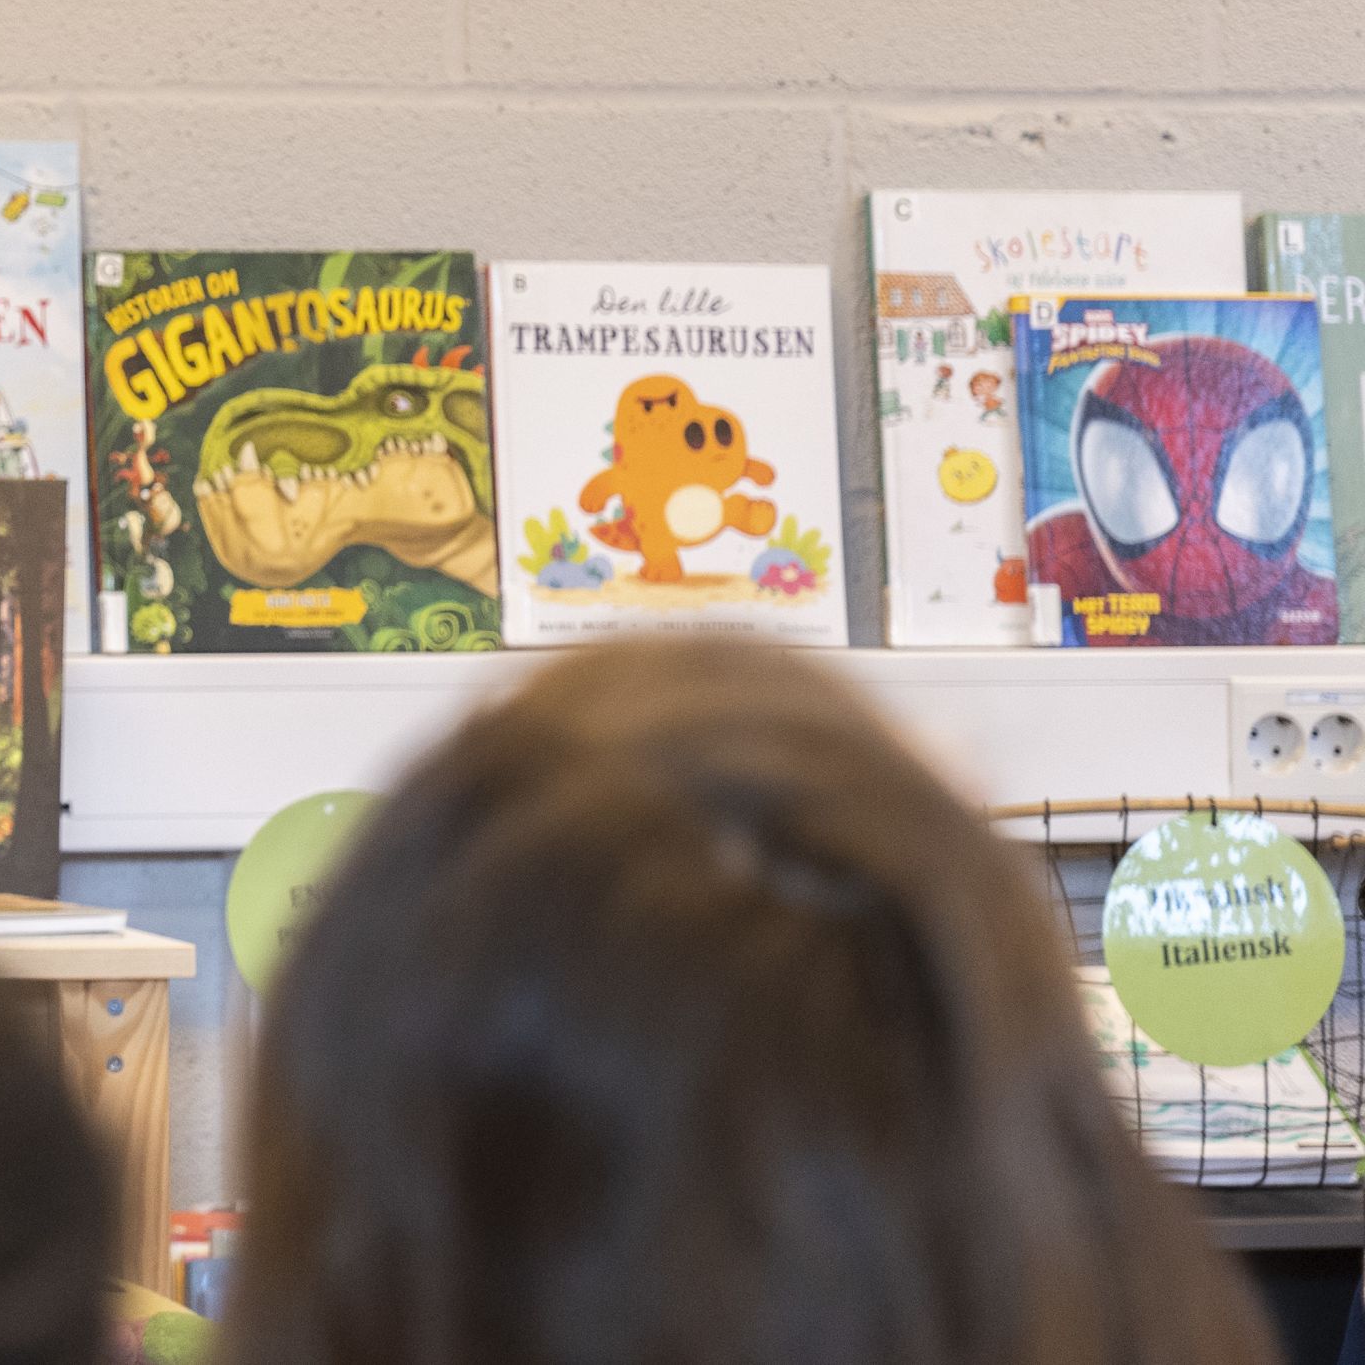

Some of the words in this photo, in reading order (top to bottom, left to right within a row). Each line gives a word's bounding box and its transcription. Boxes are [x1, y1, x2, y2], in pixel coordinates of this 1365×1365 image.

[894, 198, 912, 221] C
[975, 226, 1149, 274] skolestart
[1284, 227, 1299, 247] L
[591, 284, 647, 315] Den
[657, 286, 733, 315] lille
[103, 286, 468, 420] GIGANTOSAURUS
[509, 322, 815, 358] TRAMPESAURUSEN
[1161, 931, 1293, 968] Italiensk
